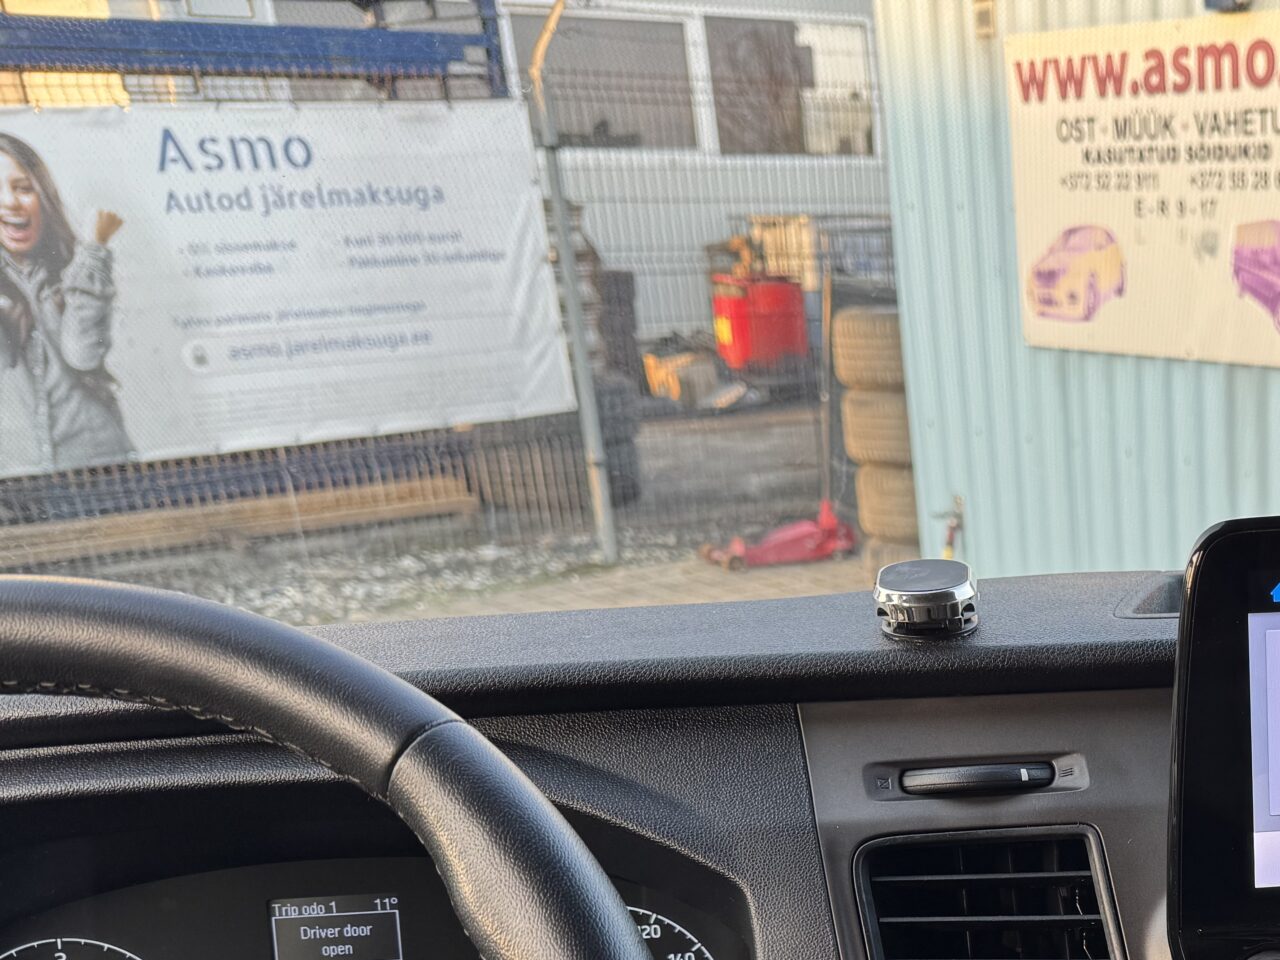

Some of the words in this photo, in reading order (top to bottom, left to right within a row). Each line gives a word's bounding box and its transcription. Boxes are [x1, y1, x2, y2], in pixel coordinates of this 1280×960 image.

[1056, 118, 1096, 143] OST
[158, 127, 313, 172] Asmo
[165, 186, 252, 214] Autod
[260, 182, 445, 216] järelmaksuga
[272, 903, 299, 917] Trip
[302, 902, 326, 916] odo
[329, 901, 337, 914] 1
[374, 897, 398, 911] 11°
[300, 926, 340, 940] Driver
[343, 924, 373, 937] door
[322, 944, 353, 957] open
